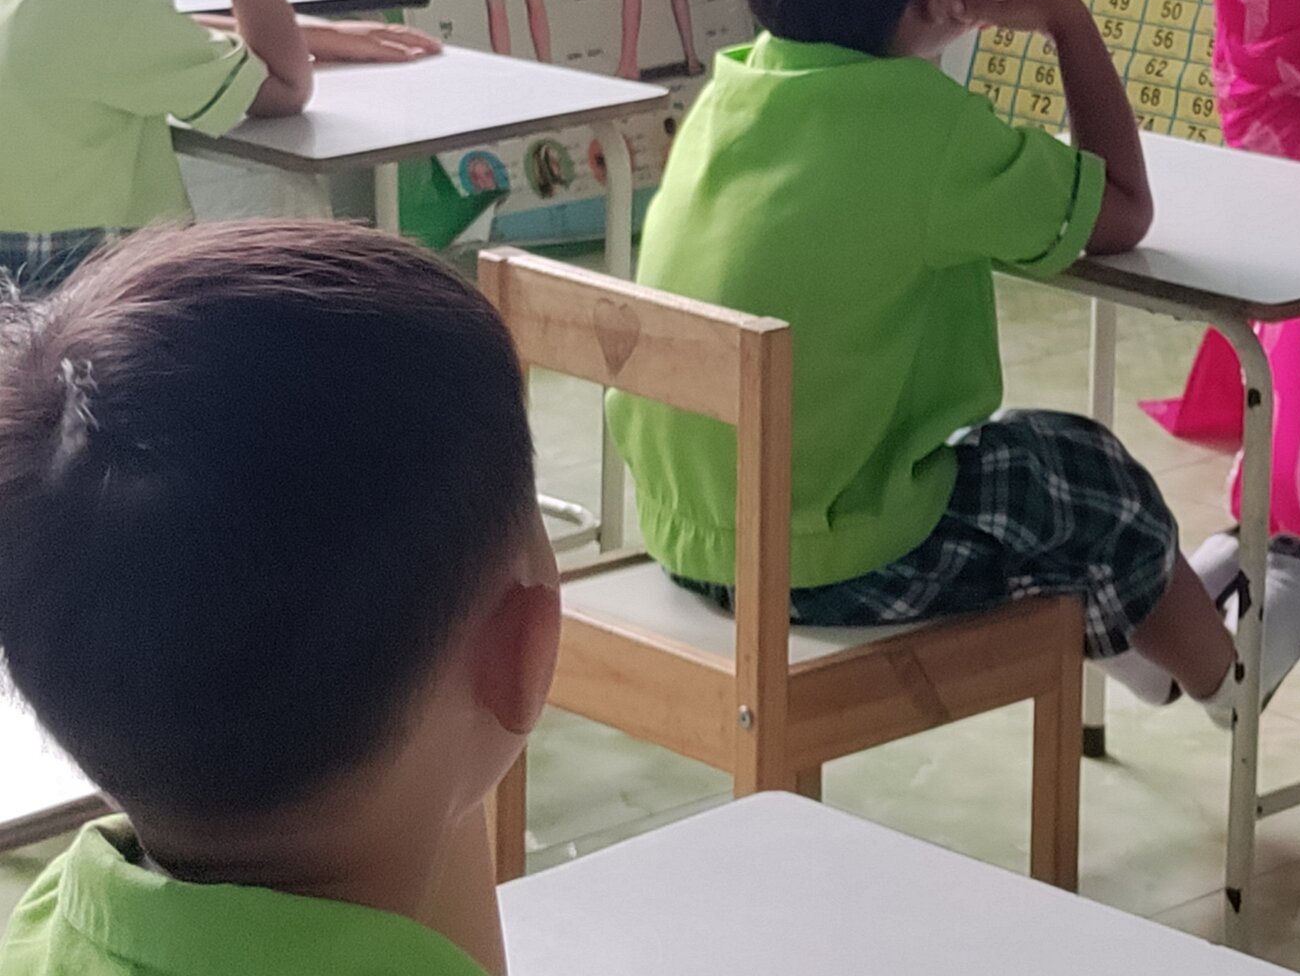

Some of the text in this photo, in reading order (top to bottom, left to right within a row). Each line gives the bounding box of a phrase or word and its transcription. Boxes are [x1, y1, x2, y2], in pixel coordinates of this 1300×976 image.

[1160, 0, 1183, 20] 50
[993, 27, 1015, 47] 59
[1145, 58, 1168, 77] 62
[1102, 20, 1124, 39] 55
[1152, 29, 1174, 49] 56
[987, 55, 1214, 117] 65 66 68 69
[1031, 94, 1052, 115] 72
[1188, 126, 1207, 142] 75
